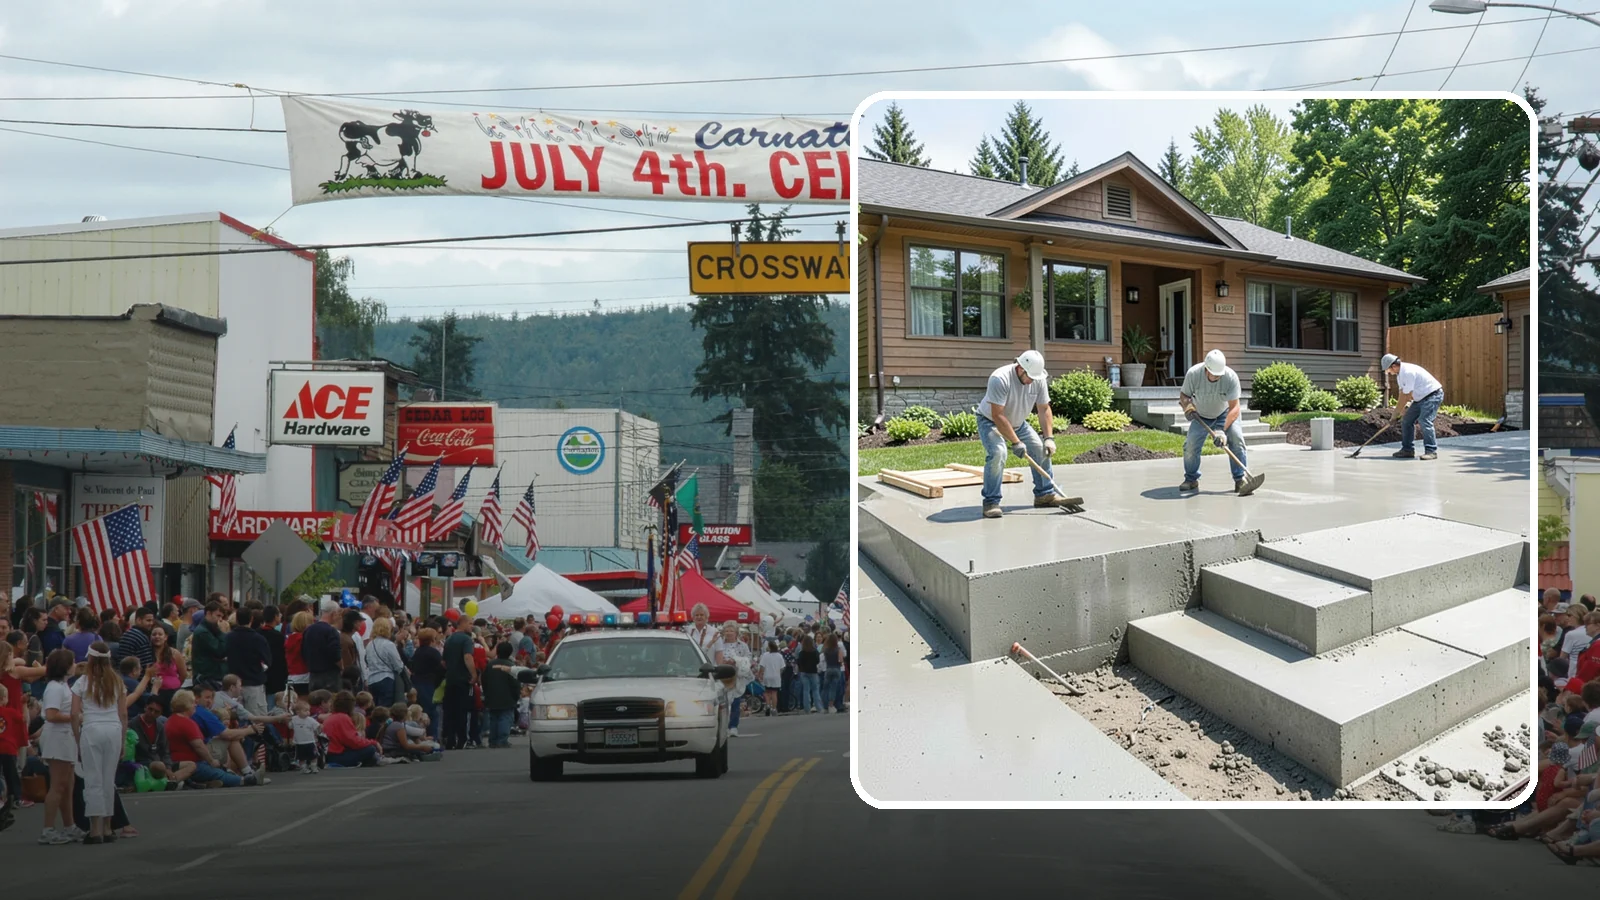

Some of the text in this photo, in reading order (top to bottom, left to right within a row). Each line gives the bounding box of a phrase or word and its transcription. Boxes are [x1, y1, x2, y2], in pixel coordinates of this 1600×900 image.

[481, 141, 605, 192] JULY
[632, 150, 747, 198] 4th.
[697, 254, 850, 280] CROSSWA
[283, 380, 374, 420] ACE
[405, 408, 453, 422] CEDAR
[284, 421, 371, 436] Hardware
[83, 485, 155, 495] St. Vincent de Paul
[688, 526, 742, 535] CRNATION
[699, 535, 730, 543] GLASS
